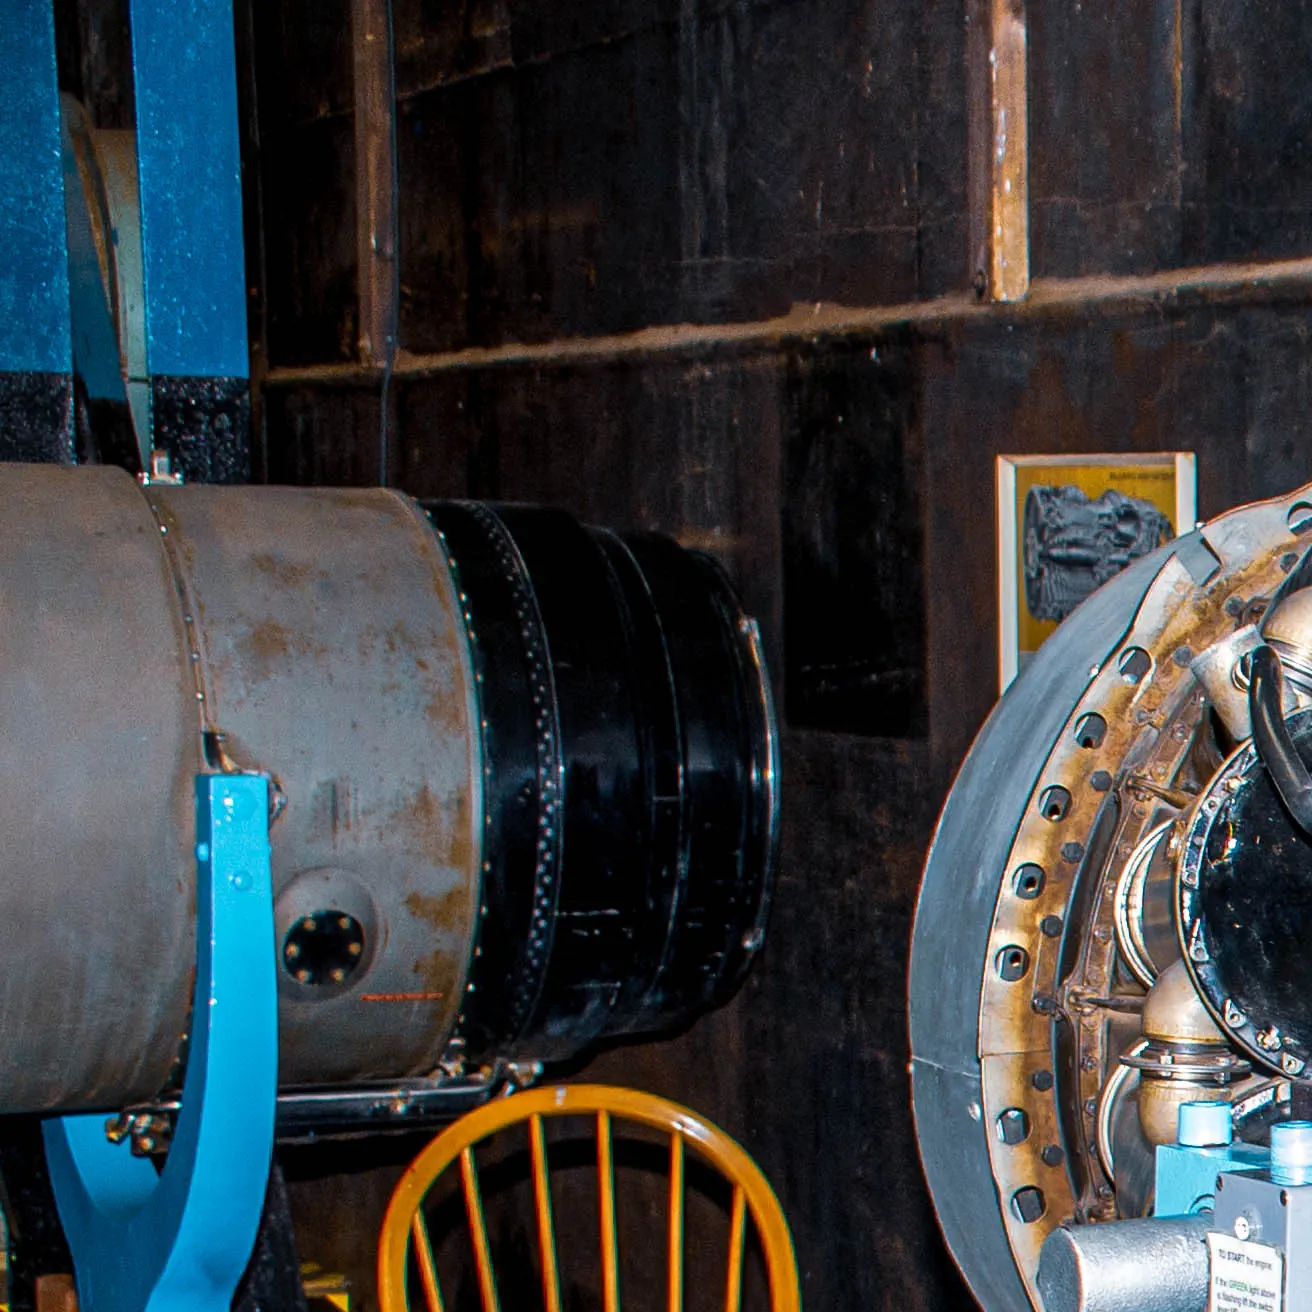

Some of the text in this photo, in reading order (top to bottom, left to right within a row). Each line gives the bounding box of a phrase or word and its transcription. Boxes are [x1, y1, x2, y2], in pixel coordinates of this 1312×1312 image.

[1218, 1249, 1226, 1260] TO
[1227, 1251, 1245, 1264] START
[1229, 1279, 1248, 1292] GREEN
